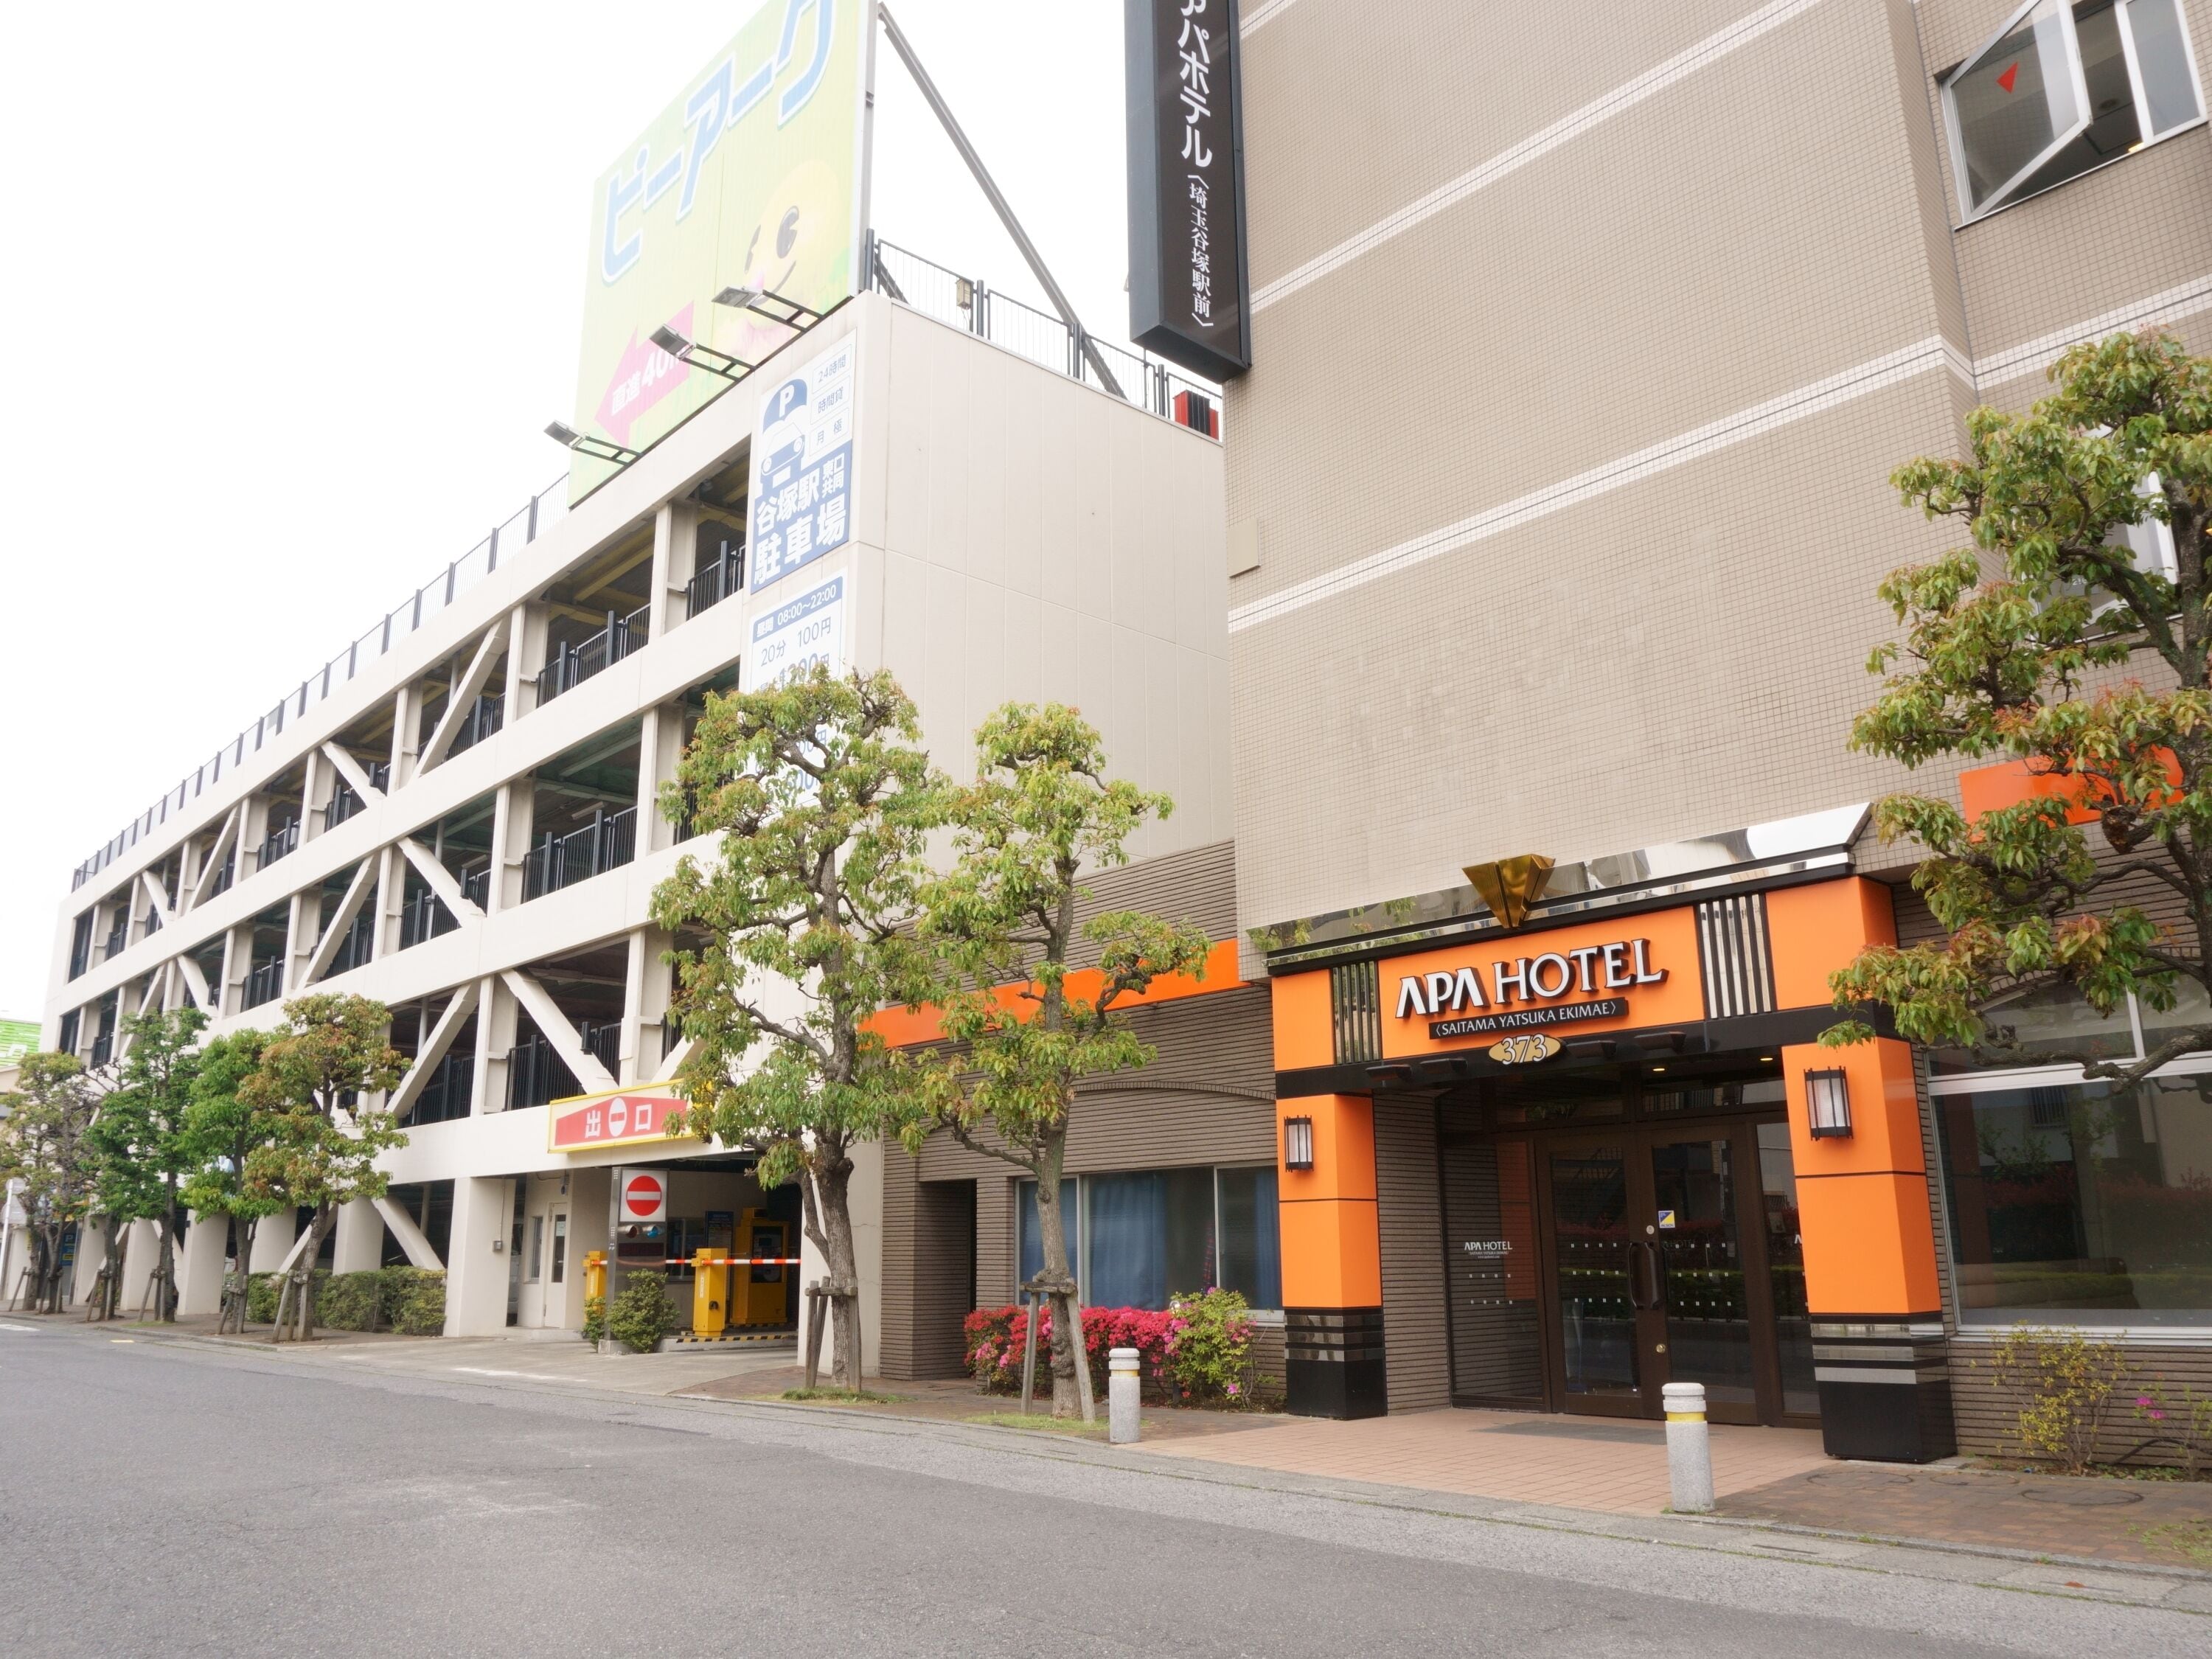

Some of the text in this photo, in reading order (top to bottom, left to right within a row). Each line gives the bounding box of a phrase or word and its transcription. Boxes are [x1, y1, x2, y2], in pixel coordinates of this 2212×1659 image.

[818, 354, 846, 383] 24時間
[611, 369, 641, 417] 直進
[779, 385, 795, 418] P
[818, 386, 844, 414] 時間貸
[823, 453, 844, 479] 東口
[822, 470, 844, 498] 共同
[757, 467, 820, 536] 谷塚駅
[754, 493, 846, 584] 駐車場
[761, 616, 831, 667] 20分 100円
[1396, 939, 1669, 1018] APA HOTEL
[1499, 1009, 1557, 1029] YATSUKA
[1501, 1033, 1548, 1065] 373
[1464, 1241, 1513, 1251] APA HOTEL
